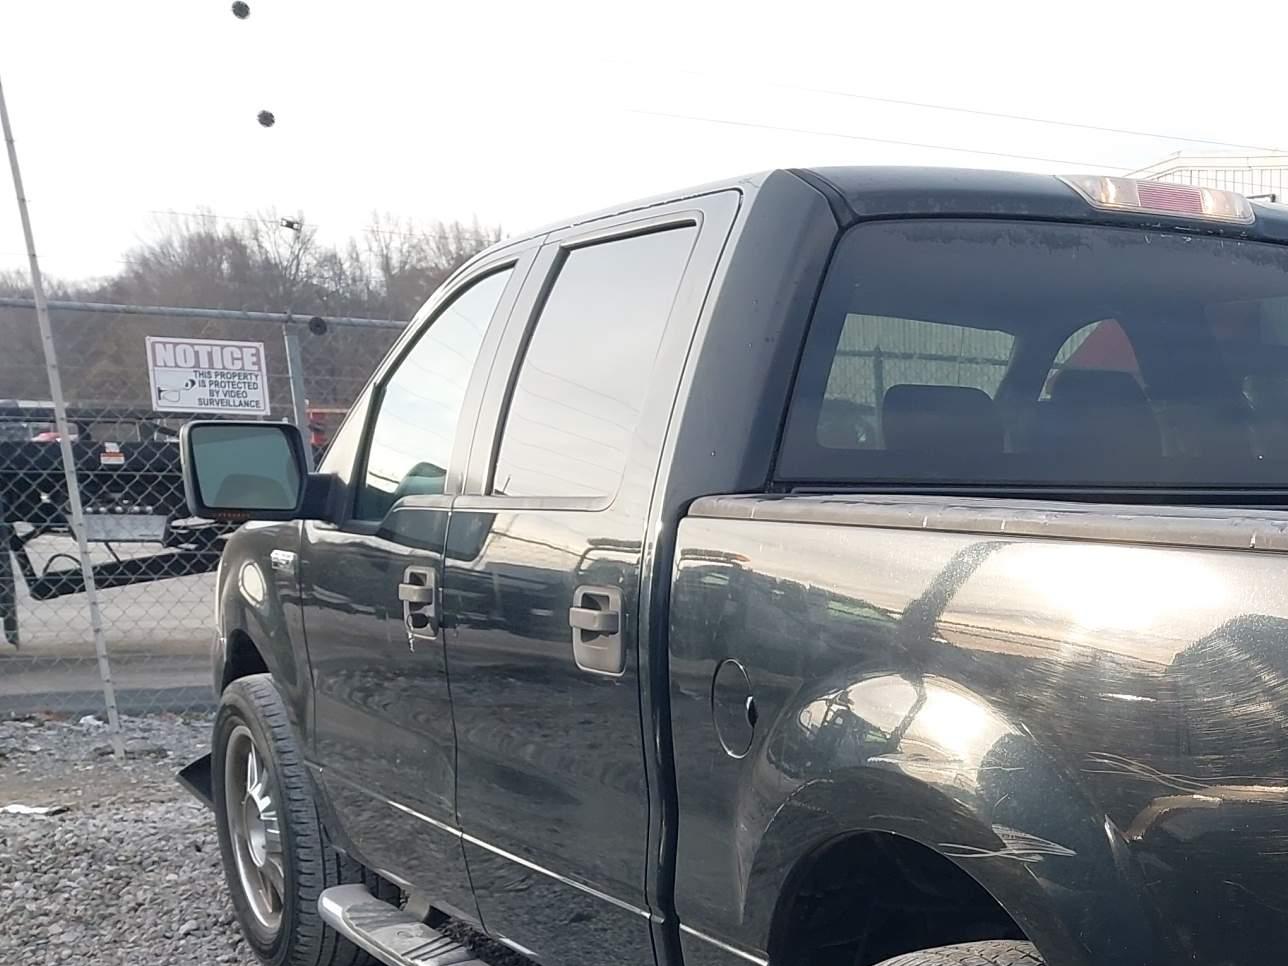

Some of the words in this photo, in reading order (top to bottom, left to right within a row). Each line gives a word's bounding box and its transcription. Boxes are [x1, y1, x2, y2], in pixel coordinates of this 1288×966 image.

[154, 343, 259, 370] NOTICE
[194, 370, 211, 379] THIS
[215, 371, 259, 381] PROPERTY
[198, 380, 206, 388] IS
[209, 380, 258, 390] PROTECTED
[209, 390, 220, 398] BY
[223, 390, 248, 398] VIDEO
[198, 398, 261, 408] SURVEILLANCE
